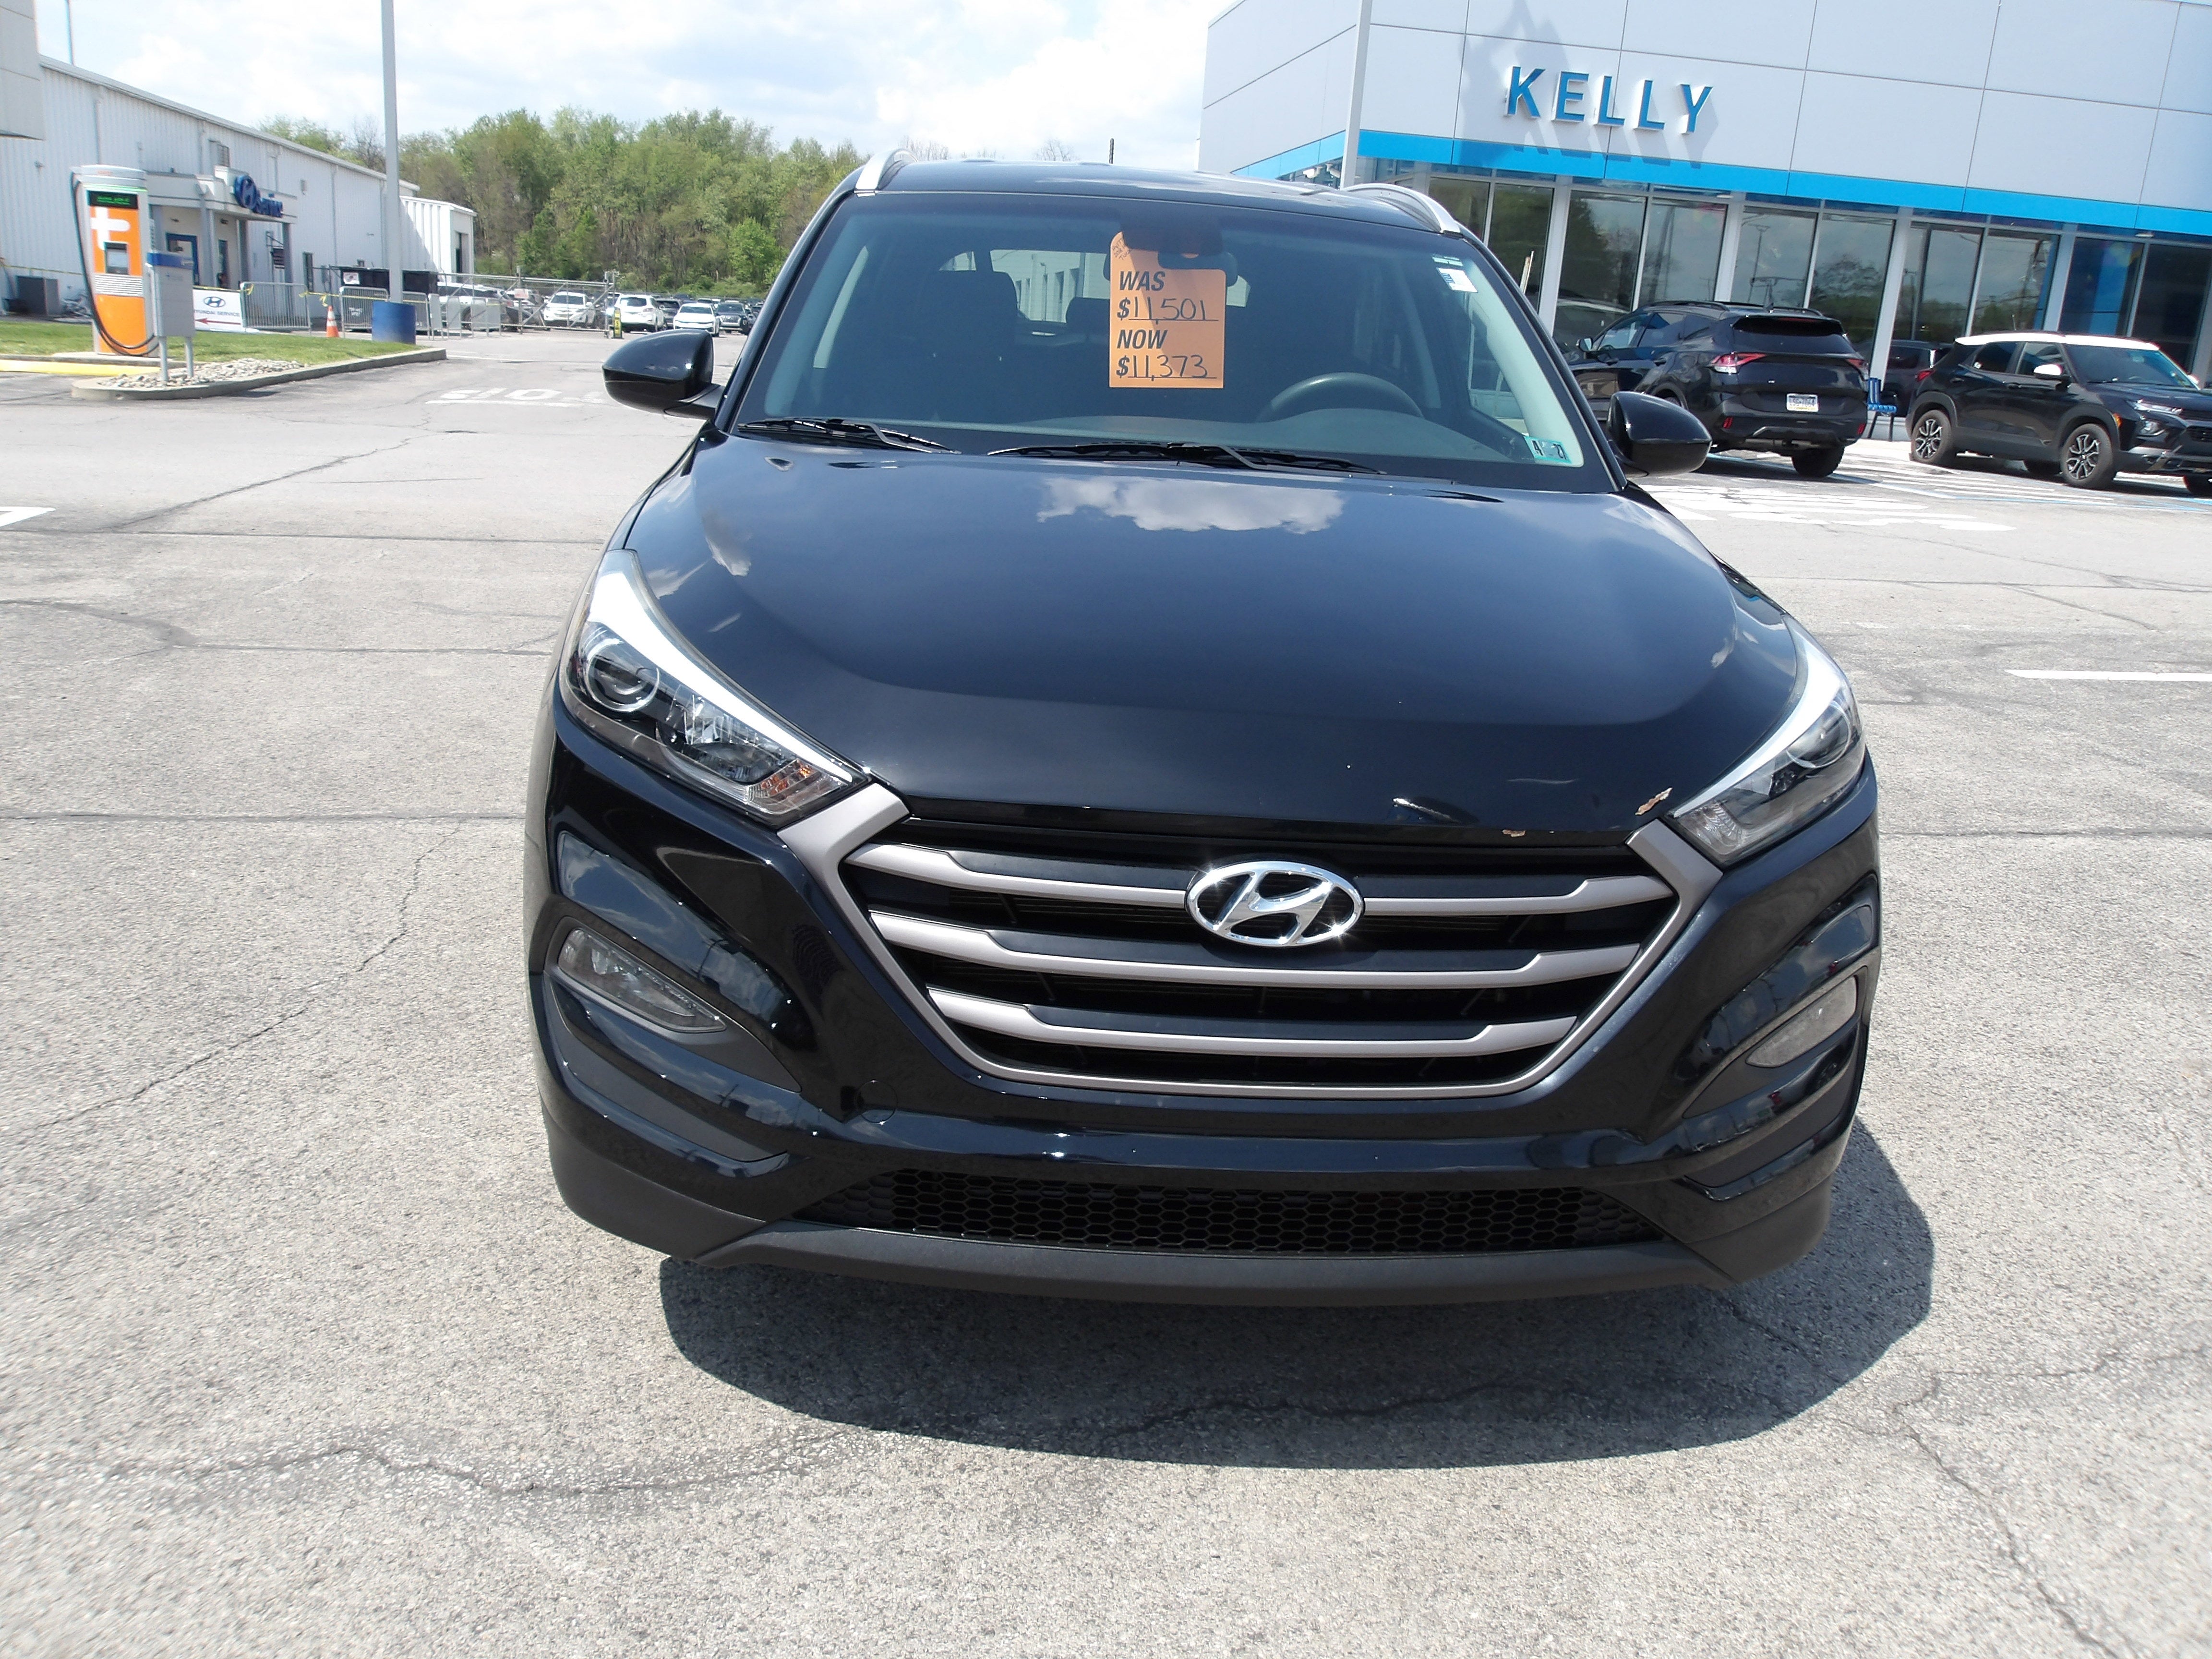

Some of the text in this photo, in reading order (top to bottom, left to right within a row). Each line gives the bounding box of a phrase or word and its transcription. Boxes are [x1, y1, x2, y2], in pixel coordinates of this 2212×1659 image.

[1504, 66, 1713, 134] KELLY
[1119, 271, 1166, 291] WAS
[1117, 297, 1206, 324] $11,501
[1117, 330, 1167, 349] NOW
[1116, 355, 1207, 381] $11,373
